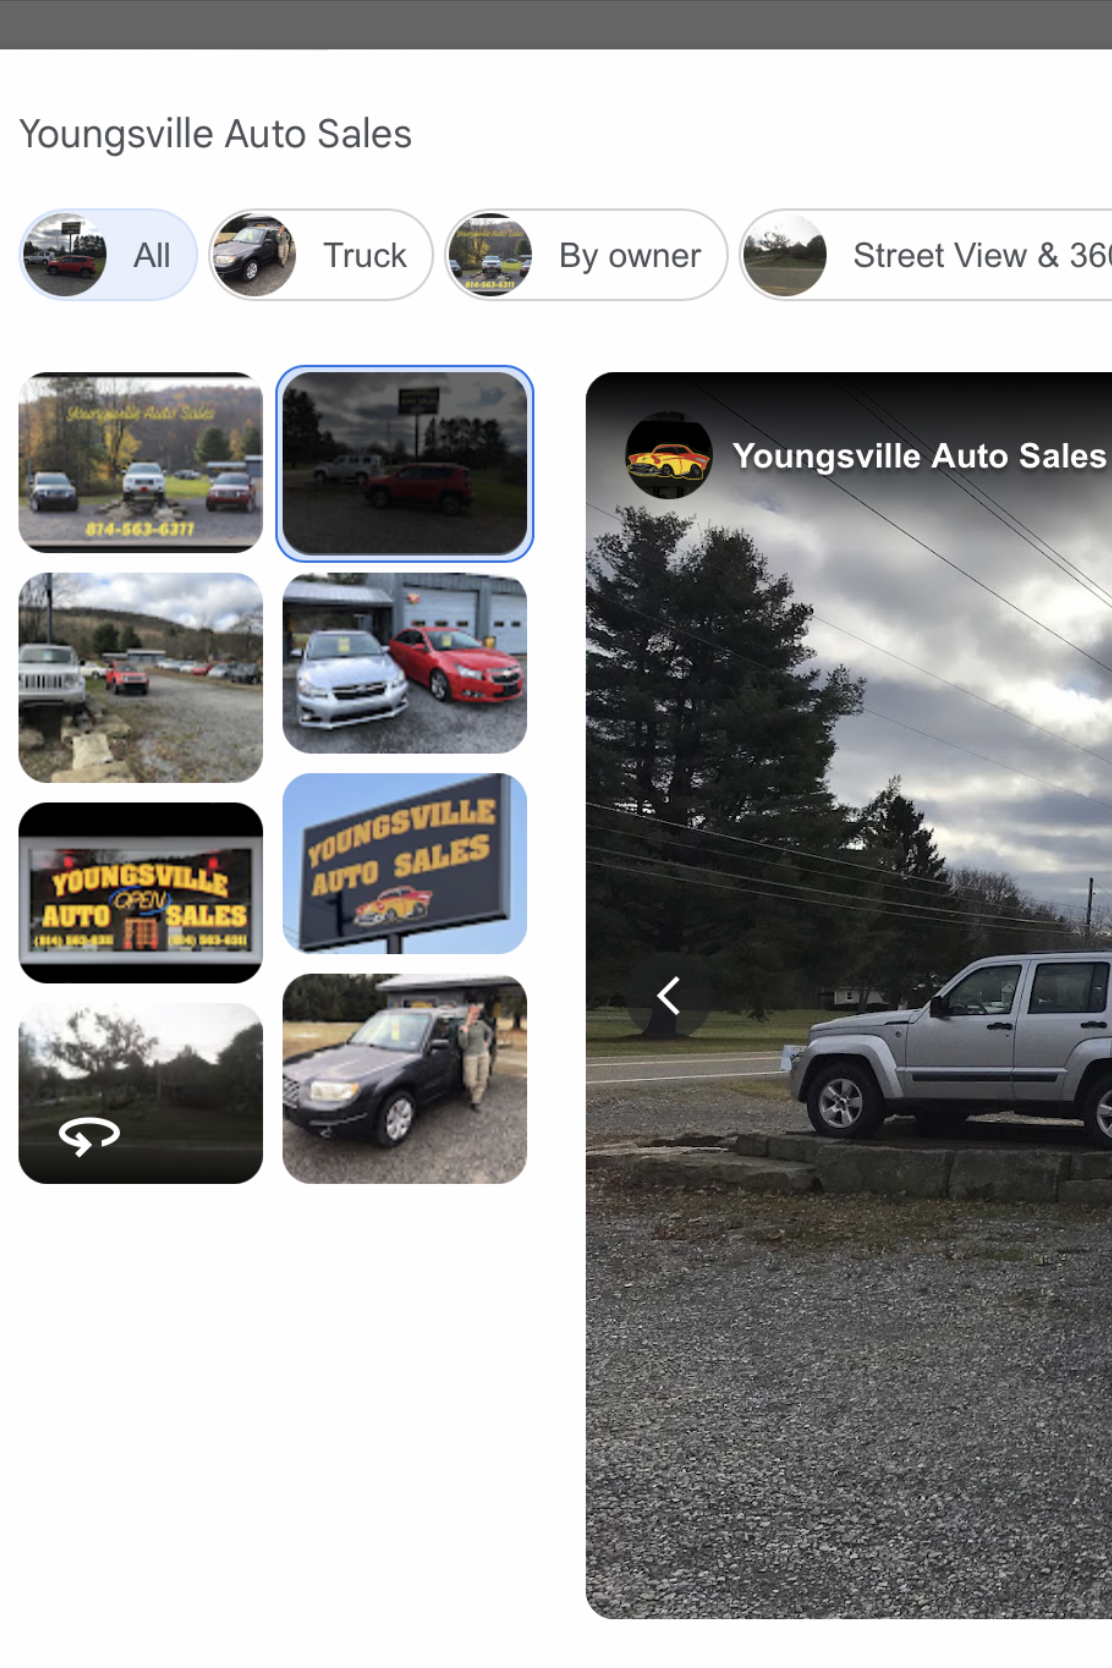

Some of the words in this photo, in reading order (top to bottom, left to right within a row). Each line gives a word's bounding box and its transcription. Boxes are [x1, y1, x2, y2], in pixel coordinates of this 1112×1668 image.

[20, 116, 214, 157] Youngsville
[225, 117, 306, 149] Auto
[318, 117, 412, 149] Sales
[133, 241, 170, 268] All
[324, 242, 408, 268] Truck
[560, 242, 599, 275] By
[609, 248, 702, 268] owner
[854, 241, 945, 268] Street
[953, 242, 1028, 268] View
[1037, 241, 1060, 268] &
[308, 798, 496, 868] YOUNGSVILLE
[52, 863, 229, 898] YOUNGSVILLE
[311, 860, 379, 897] AUTO
[394, 834, 491, 878] SALES
[113, 890, 167, 910] OPEN
[42, 905, 112, 928] AUTO
[165, 905, 248, 928] SALES
